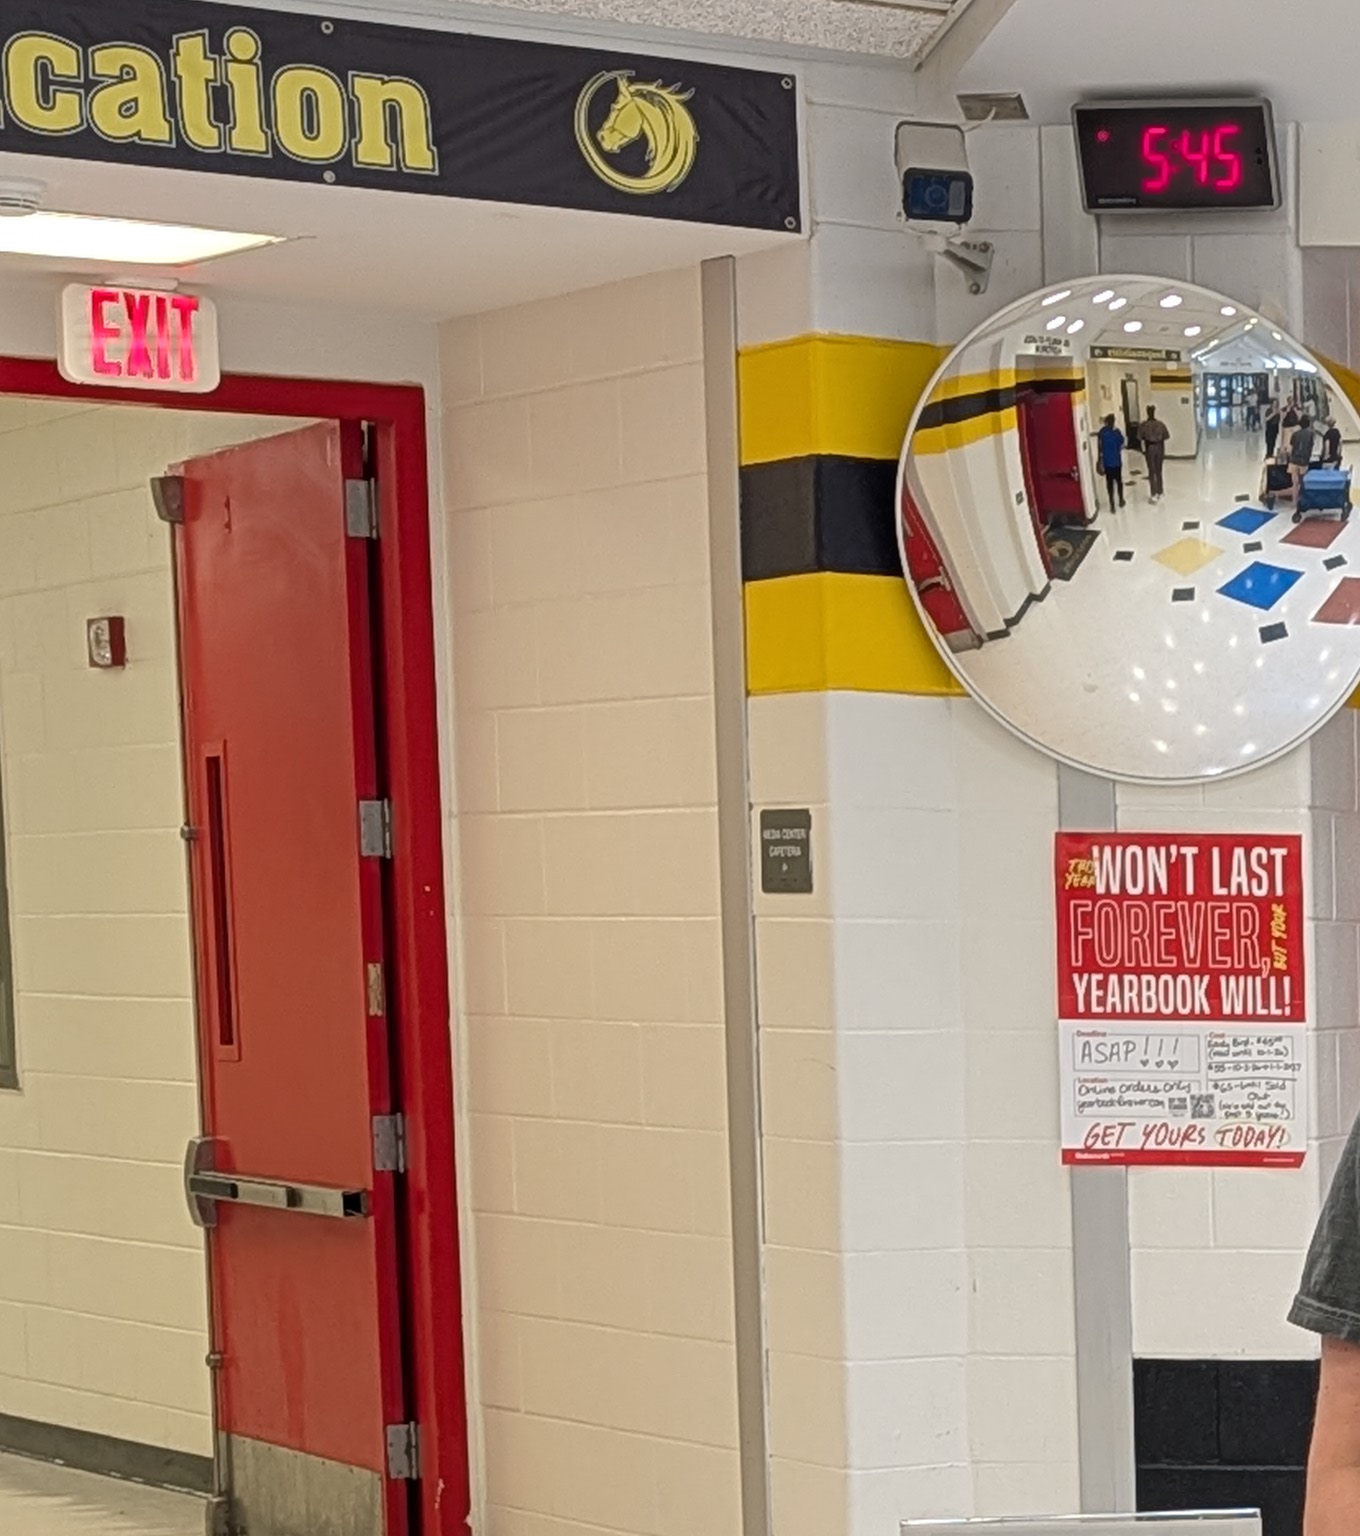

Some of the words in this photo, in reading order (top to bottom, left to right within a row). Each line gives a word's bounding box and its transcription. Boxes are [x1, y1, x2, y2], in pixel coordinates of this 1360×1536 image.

[0, 26, 441, 176] cation
[1142, 126, 1242, 193] 5:45
[91, 289, 199, 382] EXIT
[1092, 845, 1199, 896] WON'T
[1212, 846, 1288, 897] LAST
[1070, 900, 1271, 978] FOREVER,
[1072, 973, 1210, 1015] YEARBOOK
[1219, 975, 1291, 1016] WILL!
[1083, 1122, 1136, 1150] GET
[1141, 1122, 1205, 1150] YOURS
[1216, 1126, 1287, 1149] TODAY!
